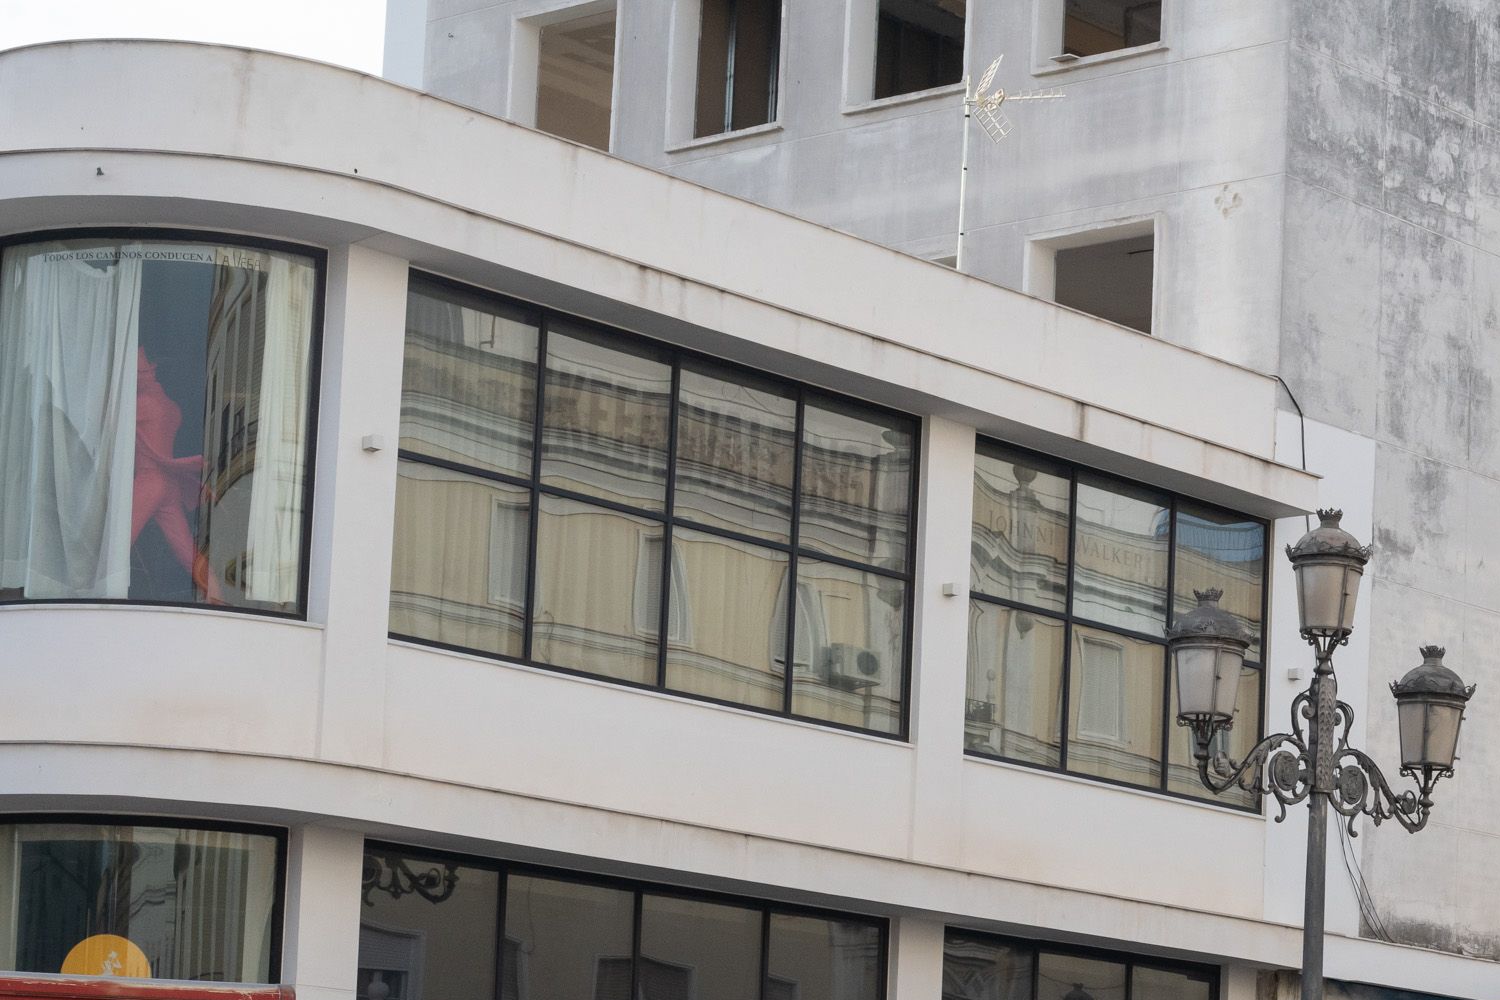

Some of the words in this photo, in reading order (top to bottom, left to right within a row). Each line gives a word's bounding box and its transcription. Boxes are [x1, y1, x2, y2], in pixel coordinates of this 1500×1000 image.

[76, 252, 94, 260] LOS
[96, 250, 142, 260] CAMINOS
[144, 251, 204, 261] CONDUCEN
[206, 254, 212, 262] A
